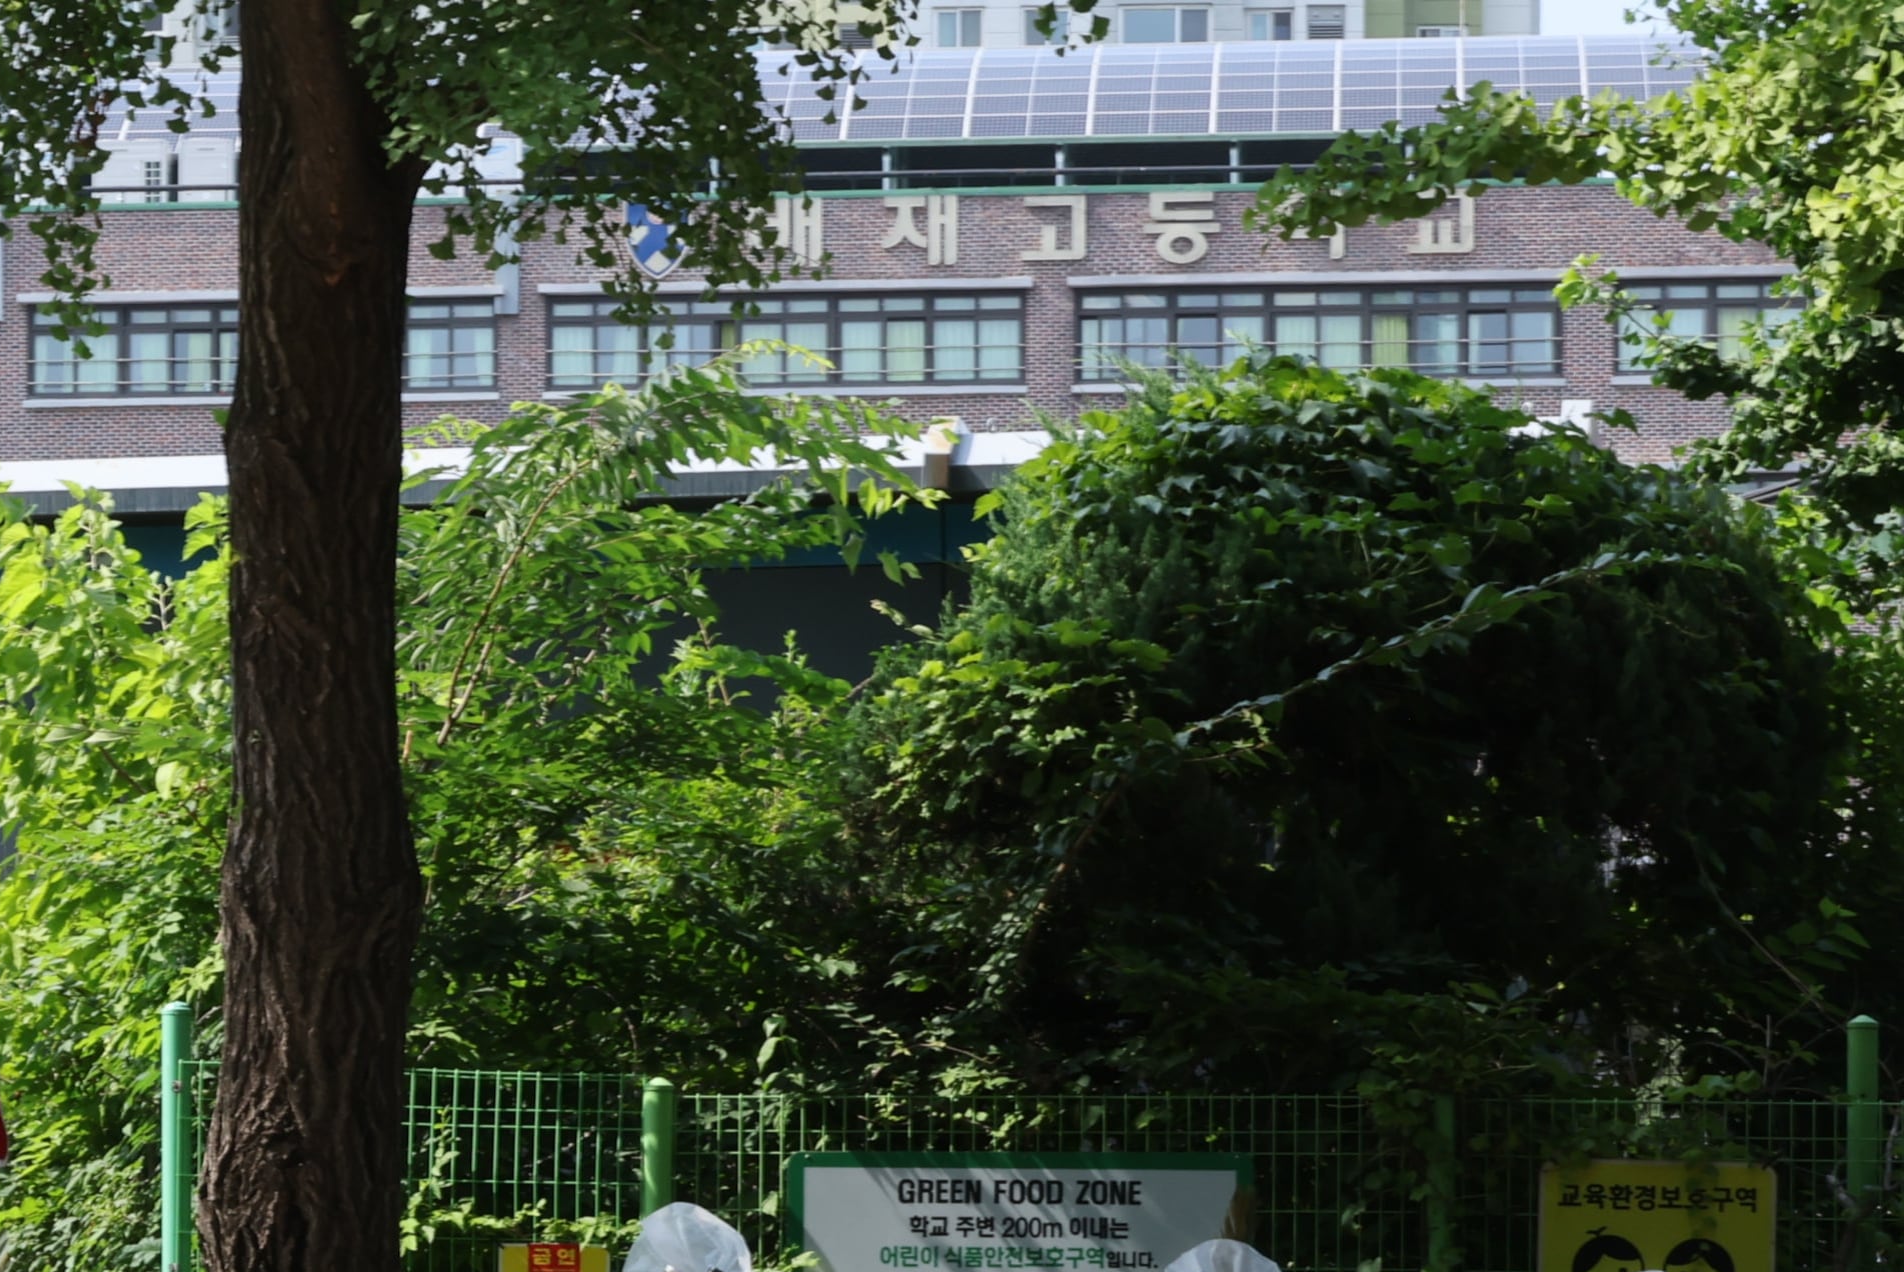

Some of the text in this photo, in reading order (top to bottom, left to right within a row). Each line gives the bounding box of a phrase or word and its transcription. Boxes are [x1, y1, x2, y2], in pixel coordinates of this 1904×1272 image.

[898, 1179, 1142, 1206] GREEN FOOD ZONE
[1557, 1184, 1759, 1213] 교육환경보호구역
[910, 1215, 1129, 1239] 학교 주변 200m 이내는
[533, 1248, 576, 1265] 금연
[880, 1246, 939, 1268] 어린이
